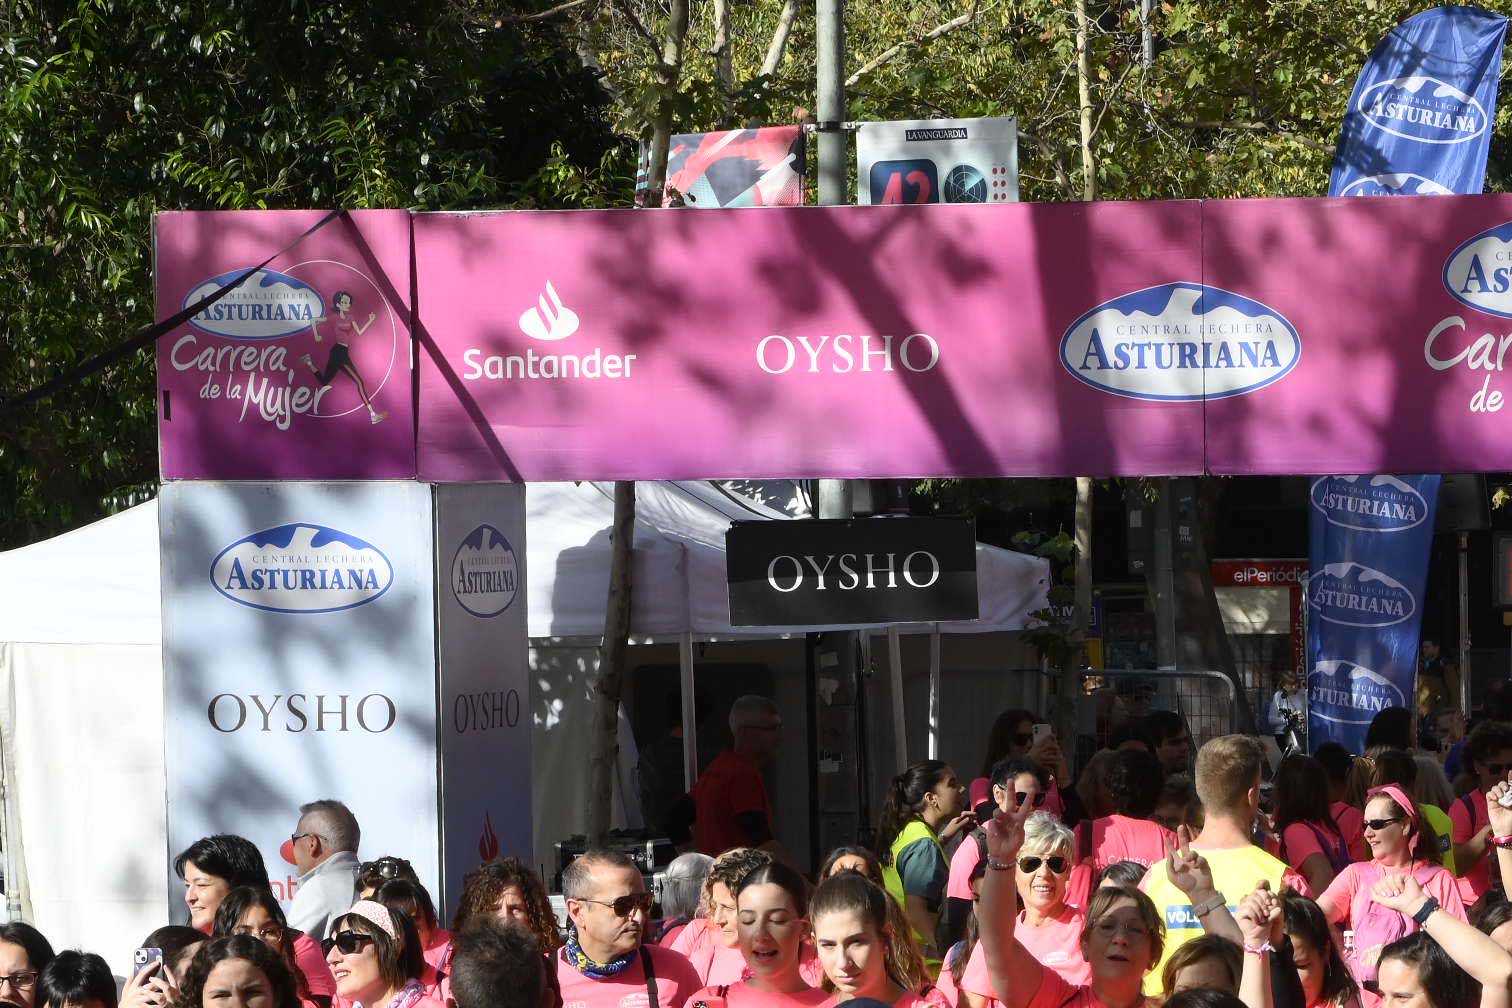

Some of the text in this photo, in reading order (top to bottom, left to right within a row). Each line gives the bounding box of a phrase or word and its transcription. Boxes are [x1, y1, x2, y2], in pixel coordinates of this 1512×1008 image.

[1369, 92, 1475, 132] ASTURIANA
[906, 129, 967, 140] LA VANGUARDIA
[195, 295, 314, 321] ASTURIANA
[220, 291, 257, 300] ENTRAL
[1116, 323, 1273, 336] CENTRAL LECHERA
[171, 335, 287, 371] Carrera
[463, 347, 636, 380] Santander
[756, 333, 940, 375] OYSHO
[1079, 327, 1282, 371] ASTURIANA
[200, 369, 332, 431] de la Mujer
[1470, 374, 1504, 413] de
[1320, 484, 1417, 522] ASTURIANA
[225, 557, 379, 590] ASTURIANA
[253, 554, 374, 563] CENTRAL LECHERA
[767, 550, 940, 592] OYSHO
[1234, 567, 1304, 583] elPeriódi
[457, 560, 514, 594] ASTURIANA
[207, 693, 396, 733] OYSHO
[454, 689, 520, 733] OYSHO
[1308, 687, 1393, 712] STURIANA
